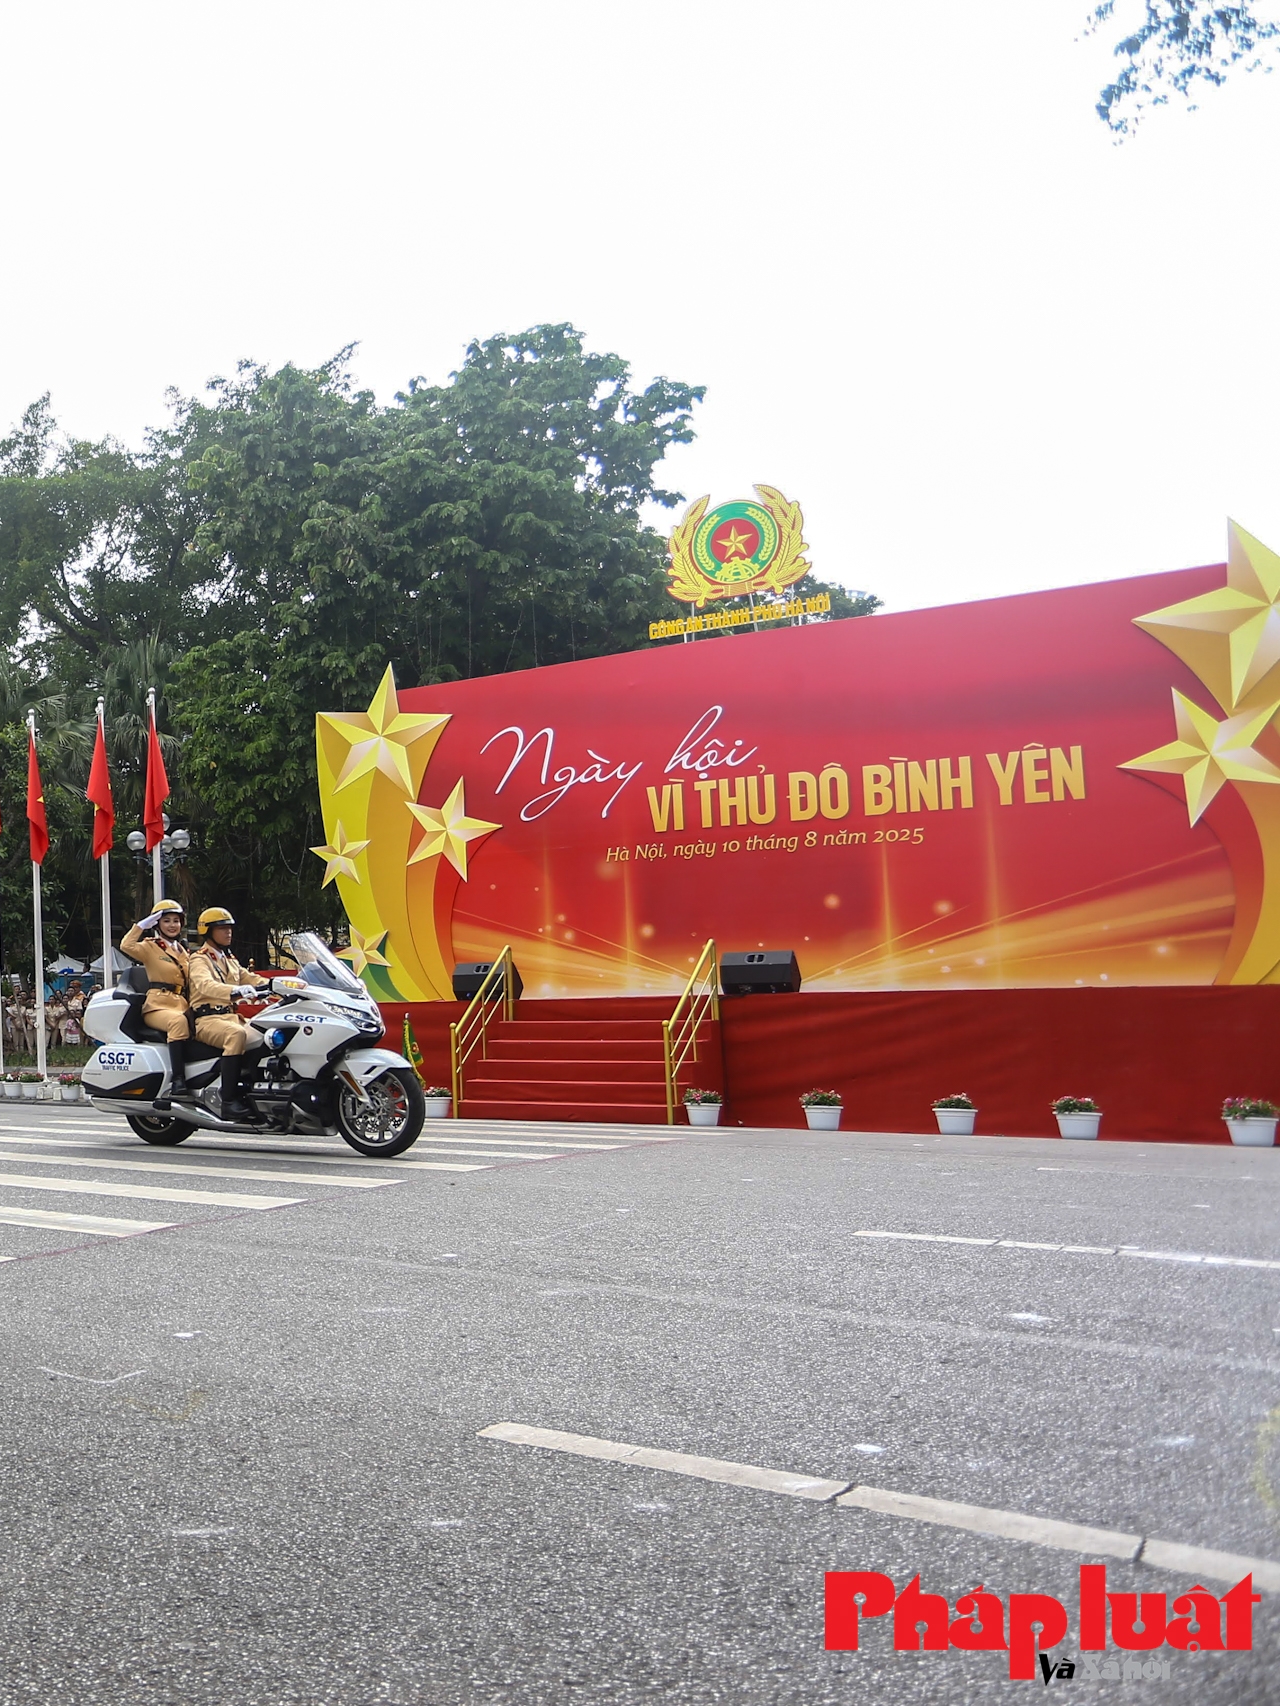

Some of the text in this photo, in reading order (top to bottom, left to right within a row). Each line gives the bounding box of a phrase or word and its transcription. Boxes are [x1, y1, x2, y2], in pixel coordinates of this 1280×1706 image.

[649, 619, 685, 639] CÔNG
[686, 615, 703, 633] AN
[479, 705, 758, 822] Ngày hội
[646, 742, 1086, 833] VÌ THỦ ĐÔ BÌNH YÊN
[605, 827, 925, 862] Hà Nội, ngày 10 tháng 8 năm 2025
